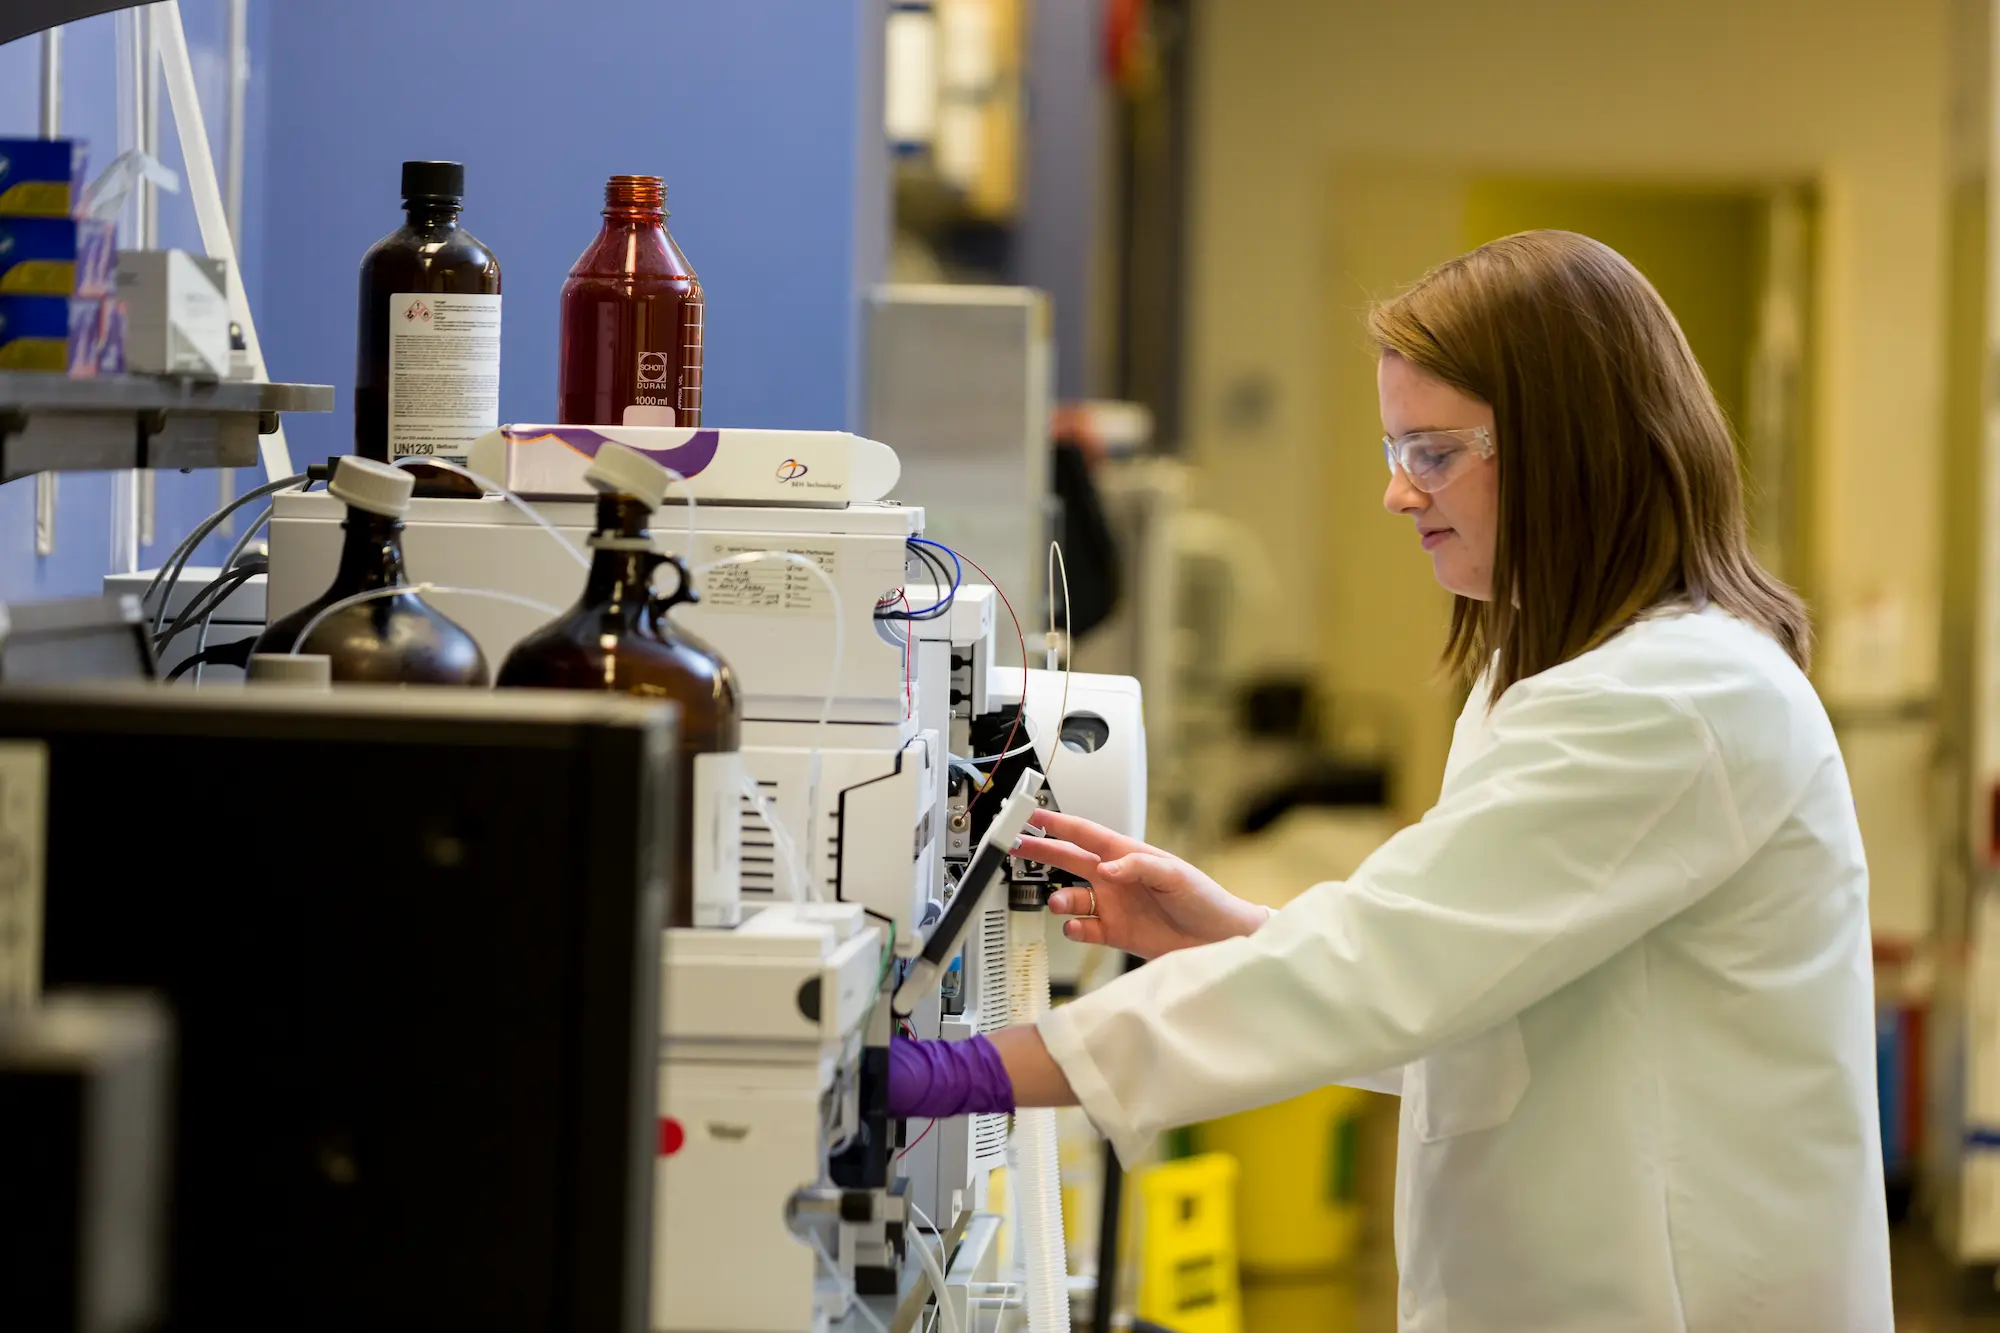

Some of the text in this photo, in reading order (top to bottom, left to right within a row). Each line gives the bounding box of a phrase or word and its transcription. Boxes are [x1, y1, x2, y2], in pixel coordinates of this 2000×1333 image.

[640, 364, 664, 372] SCHOTT
[635, 396, 668, 406] 1000 ml
[394, 443, 434, 455] UN1230
